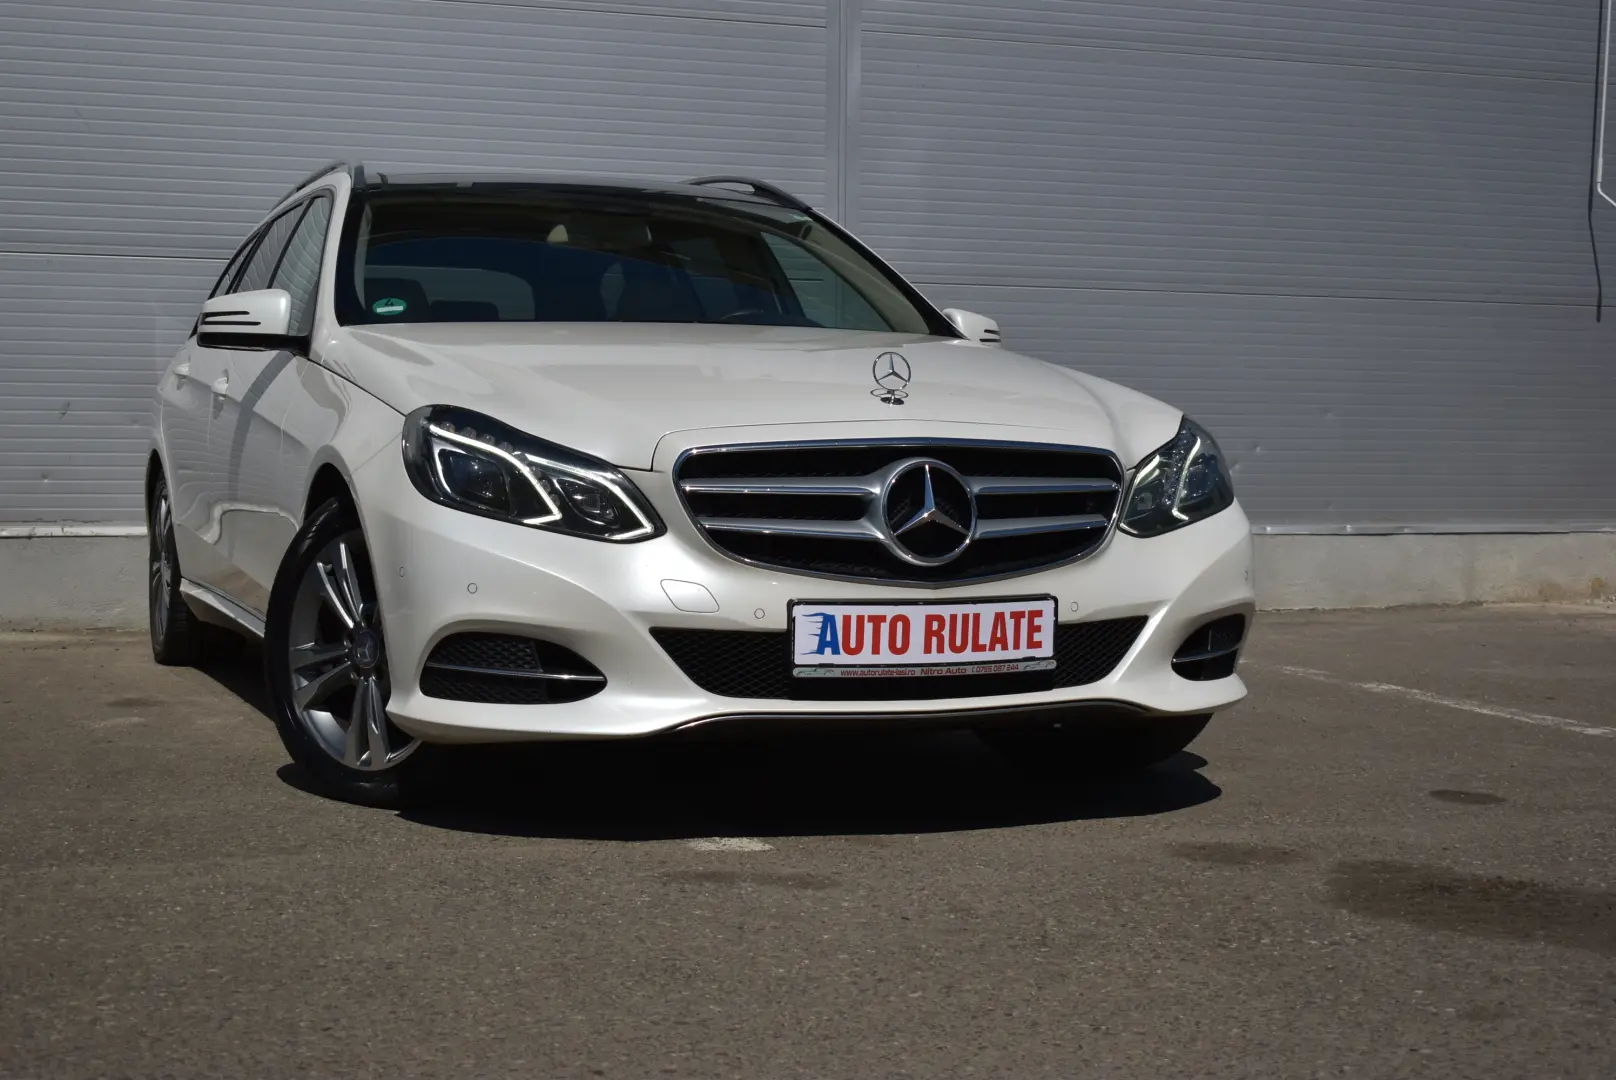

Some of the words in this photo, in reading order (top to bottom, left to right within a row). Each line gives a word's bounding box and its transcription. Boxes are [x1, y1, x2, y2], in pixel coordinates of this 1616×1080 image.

[804, 611, 911, 656] AUTO
[923, 609, 1043, 656] RULATE
[920, 667, 943, 676] Nitro
[945, 667, 967, 675] Auto
[1006, 663, 1019, 671] 244
